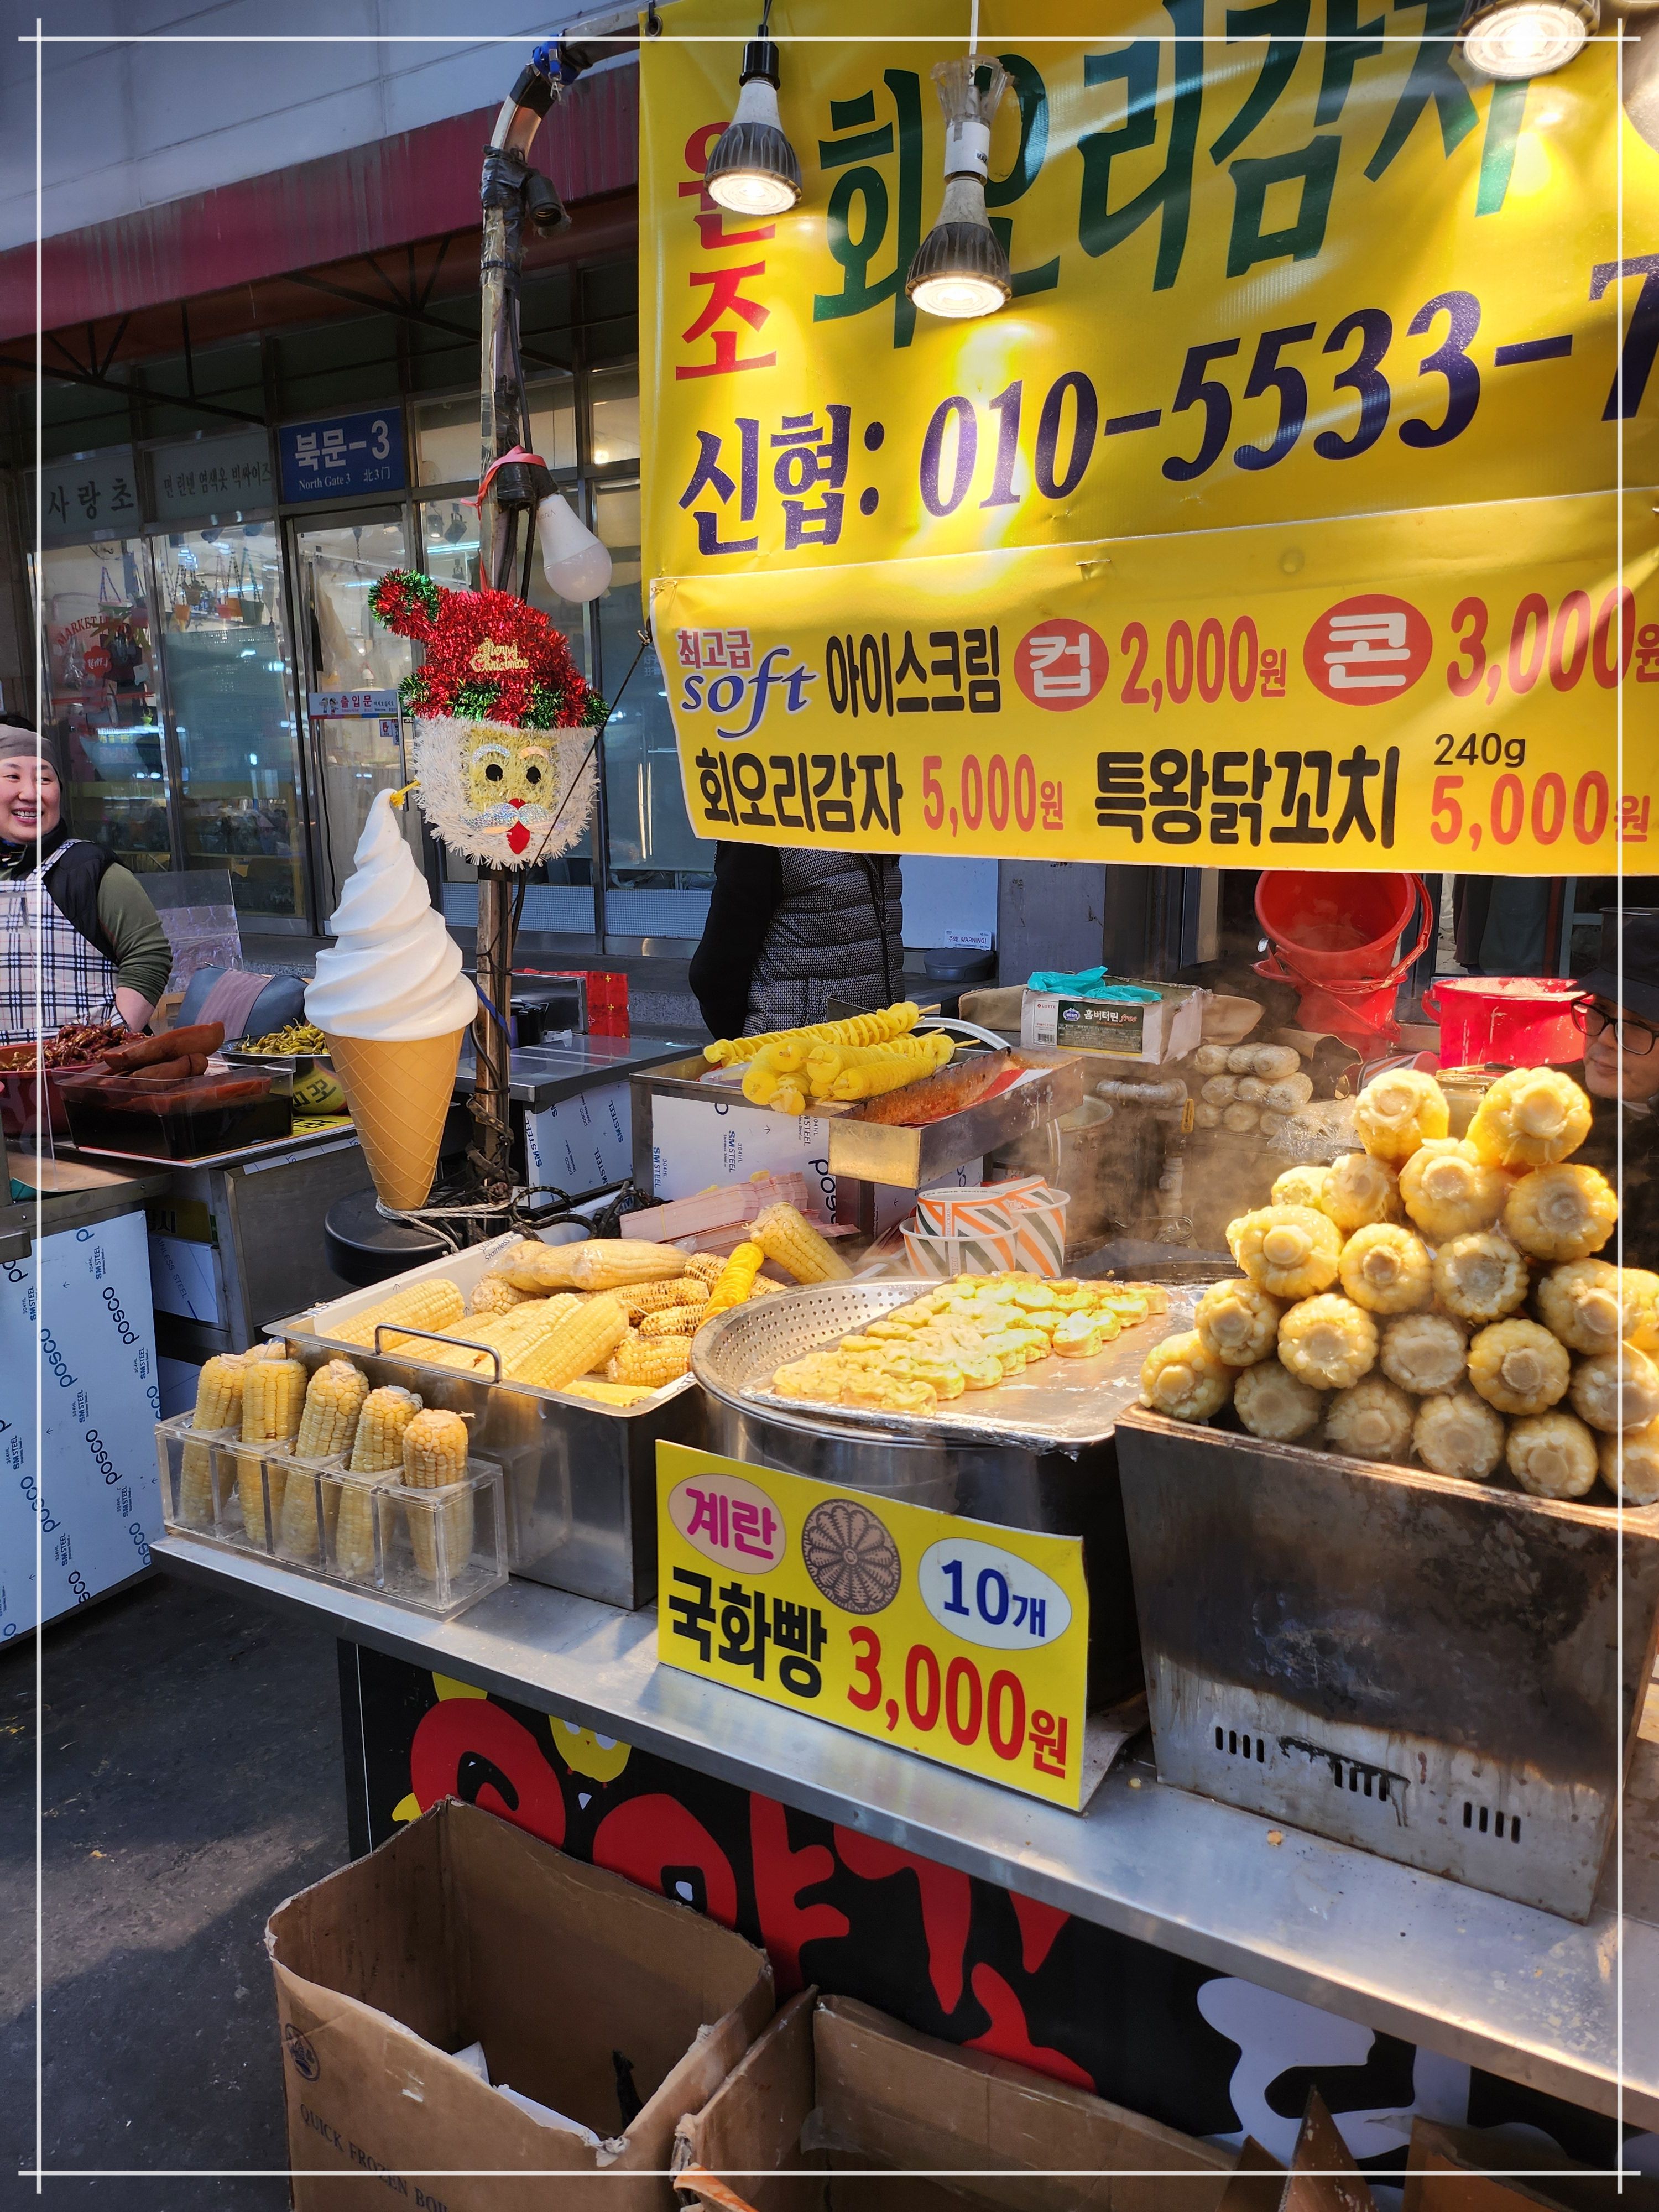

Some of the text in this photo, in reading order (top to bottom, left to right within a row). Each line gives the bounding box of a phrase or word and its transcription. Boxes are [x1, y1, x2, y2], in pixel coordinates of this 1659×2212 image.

[295, 420, 390, 471] 북문-3
[299, 477, 322, 491] North
[325, 476, 344, 486] Gate
[346, 473, 351, 484] 3
[677, 404, 886, 556] 신협:
[677, 629, 752, 669] 최고급
[681, 648, 817, 738] soft
[826, 625, 1001, 718] 아이스크림
[1029, 633, 1091, 698] 컵
[1120, 615, 1287, 713] 2,000원
[1323, 612, 1411, 689] 콘
[340, 695, 372, 708] 출입문
[1433, 732, 1526, 768] 240g
[695, 744, 1650, 852] 회오리감자 5,000원 특왕닭꼬치 5,000원
[1084, 1009, 1119, 1022] 홈버터린
[102, 1286, 140, 1345] posco
[173, 1274, 188, 1300] STEEL
[39, 1328, 79, 1388] posco
[85, 1429, 123, 1485] posco
[20, 1475, 61, 1533] posco
[685, 1488, 777, 1560] 계란
[941, 1559, 1047, 1639] 10개
[668, 1566, 1069, 1780] 국화빵 3,000원
[300, 2103, 344, 2152] QUICK
[348, 2140, 408, 2197] FROZEN
